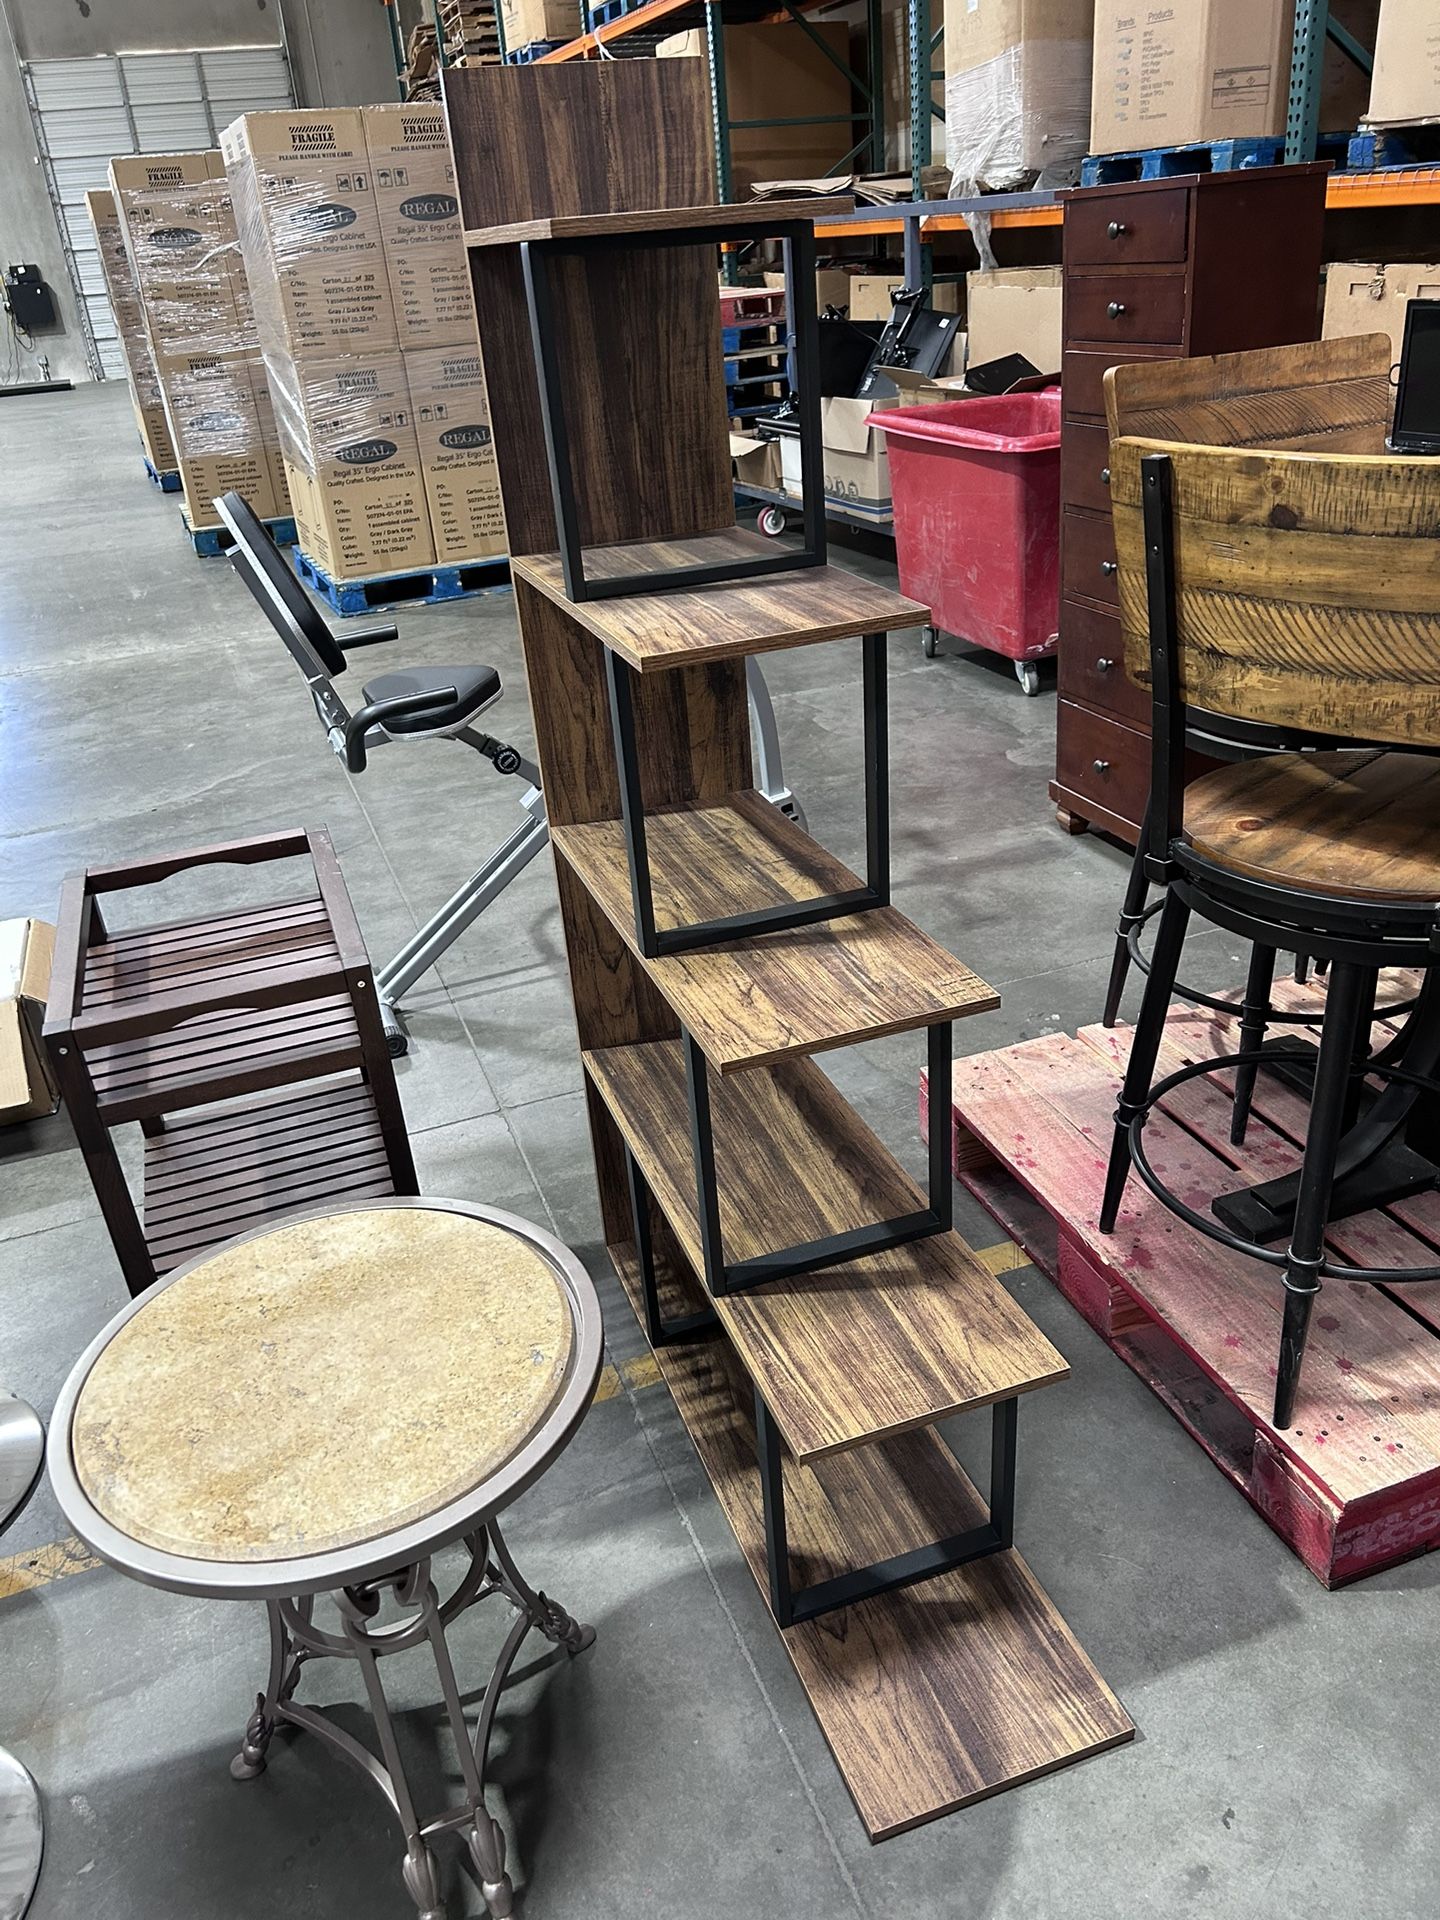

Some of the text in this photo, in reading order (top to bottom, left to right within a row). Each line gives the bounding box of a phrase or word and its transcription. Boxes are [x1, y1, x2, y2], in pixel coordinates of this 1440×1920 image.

[1148, 9, 1174, 22] Products
[1117, 18, 1136, 29] Brands
[403, 124, 445, 135] FRAGILE
[291, 132, 336, 144] FRAGILE
[148, 171, 184, 181] FRAGILE
[403, 201, 456, 216] REGAL
[398, 226, 416, 235] Regal
[430, 223, 446, 233] Ergo
[340, 232, 367, 242] Cabinet
[365, 241, 377, 249] USA
[361, 294, 382, 302] cabinet
[328, 307, 343, 315] Gray
[347, 306, 360, 314] Dark
[361, 304, 375, 313] Gray
[443, 363, 481, 375] FRAGILE
[338, 377, 378, 388] FRAGILE
[443, 431, 491, 446] REGAL
[437, 453, 455, 463] Regal
[467, 450, 482, 459] Ergo
[333, 463, 406, 479] Regal 35" Ergo Cabinet
[327, 480, 345, 488] Quality
[365, 474, 389, 483] Designed
[372, 520, 400, 528] assembled
[445, 535, 466, 543] Weight:
[344, 551, 365, 559] Weight:
